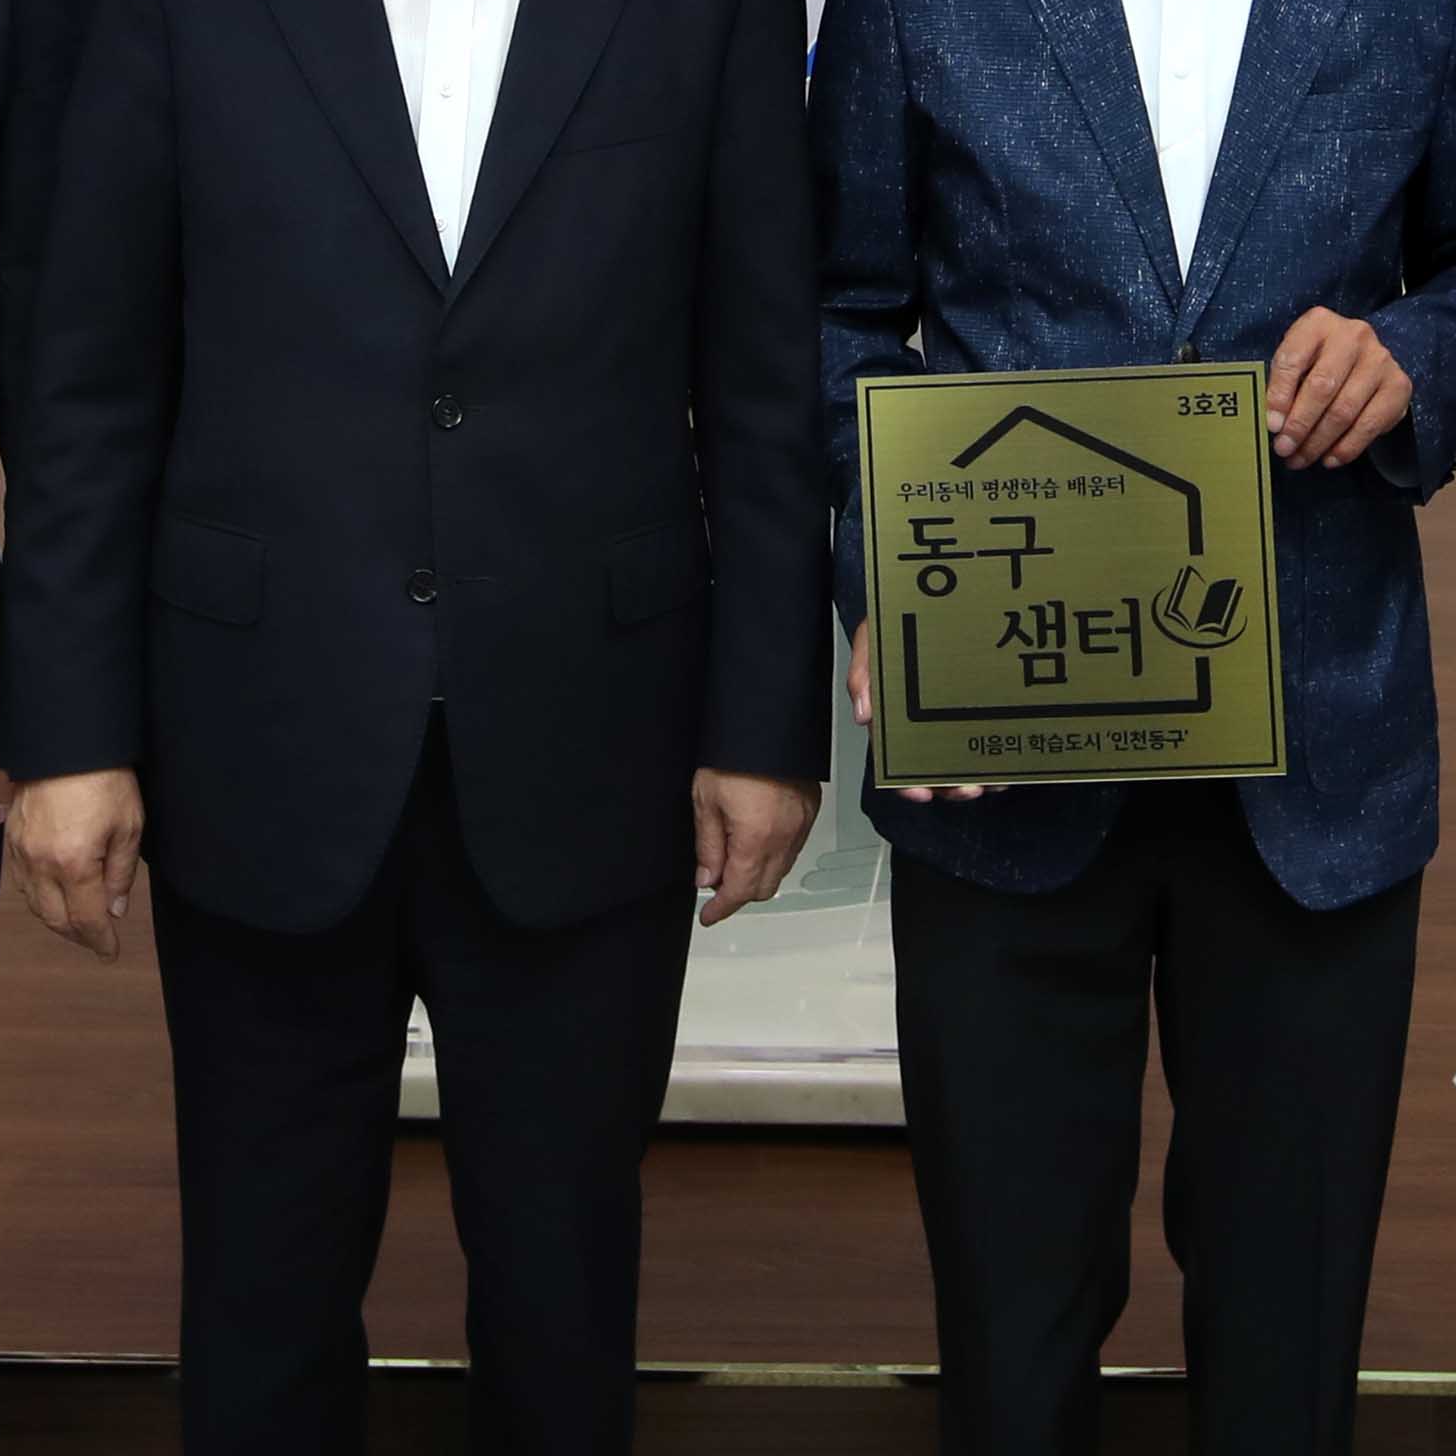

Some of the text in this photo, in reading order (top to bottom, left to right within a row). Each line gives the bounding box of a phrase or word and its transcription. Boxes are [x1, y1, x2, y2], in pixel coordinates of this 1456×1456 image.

[1177, 390, 1239, 417] 3호점
[897, 474, 1126, 503] 우리동네 평생학습 배움터
[897, 516, 1055, 598] 동구
[995, 597, 1144, 688] 샘터
[967, 734, 1023, 756] 이음의
[1027, 732, 1103, 754] 학습도시
